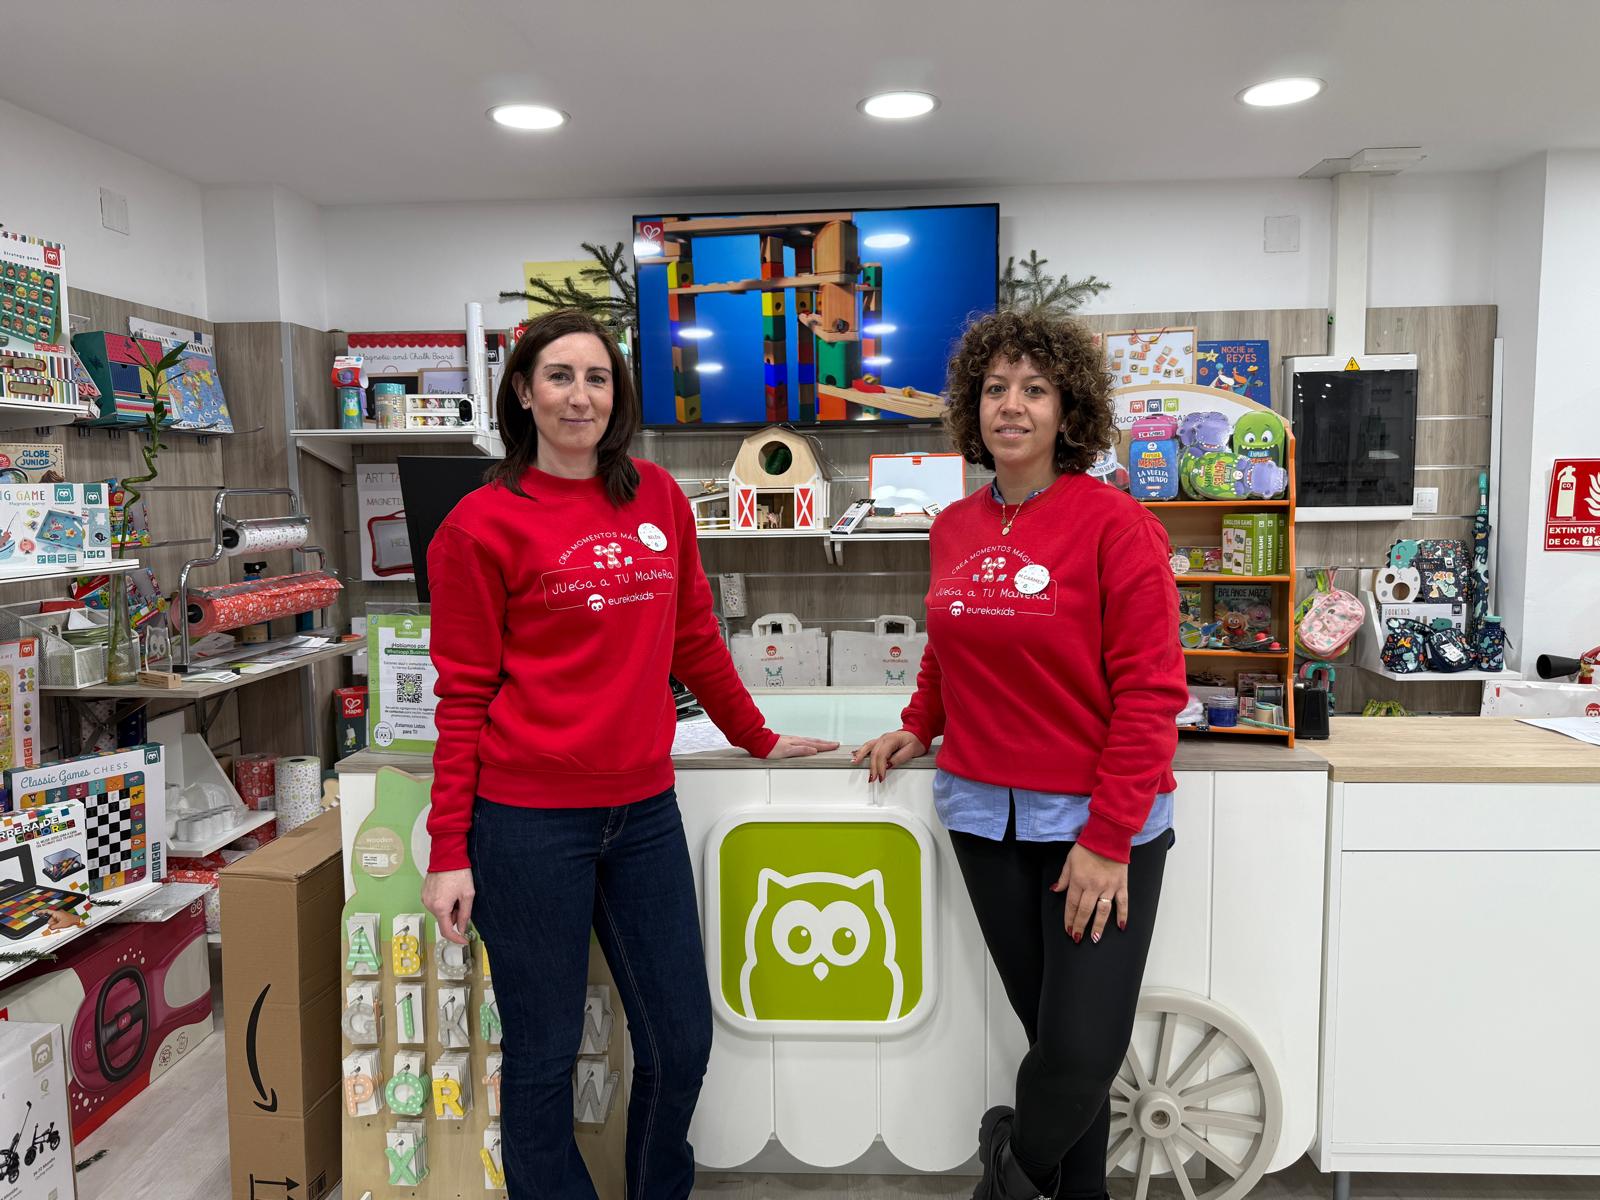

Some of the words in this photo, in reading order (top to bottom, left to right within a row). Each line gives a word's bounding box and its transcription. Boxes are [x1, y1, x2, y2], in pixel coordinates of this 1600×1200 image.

[1221, 345, 1246, 354] NOCHE
[358, 352, 388, 364] Magnetic
[391, 353, 408, 361] and
[410, 351, 431, 360] Chalk
[432, 351, 455, 361] Board
[1226, 353, 1257, 363] REYES
[22, 449, 50, 458] GLOBE
[20, 458, 50, 466] JUNIOR
[365, 472, 385, 483] ART
[1146, 469, 1169, 477] VUELTA
[1147, 476, 1169, 484] MUNDO
[16, 490, 46, 501] GAME
[558, 550, 573, 565] CREA
[571, 532, 618, 551] MOMENTOS
[1548, 538, 1560, 546] DE
[951, 559, 969, 575] CREA
[970, 545, 1012, 560] MOMENTOS
[614, 572, 630, 585] TU
[608, 591, 655, 606] eurekakids
[983, 588, 995, 598] TU
[1218, 588, 1247, 598] BALANCE
[1248, 587, 1268, 598] MAZE
[966, 606, 1016, 617] eurekakids
[20, 773, 58, 789] Classic
[58, 768, 91, 786] Games
[93, 761, 129, 775] CHESS
[43, 816, 60, 828] DE
[15, 818, 76, 844] COLORES
[346, 931, 380, 971] A
[392, 934, 421, 976] B
[439, 1003, 470, 1046] K
[344, 1074, 374, 1115] P
[385, 1072, 423, 1114] Q
[432, 1078, 464, 1116] R
[384, 1147, 416, 1184] X
